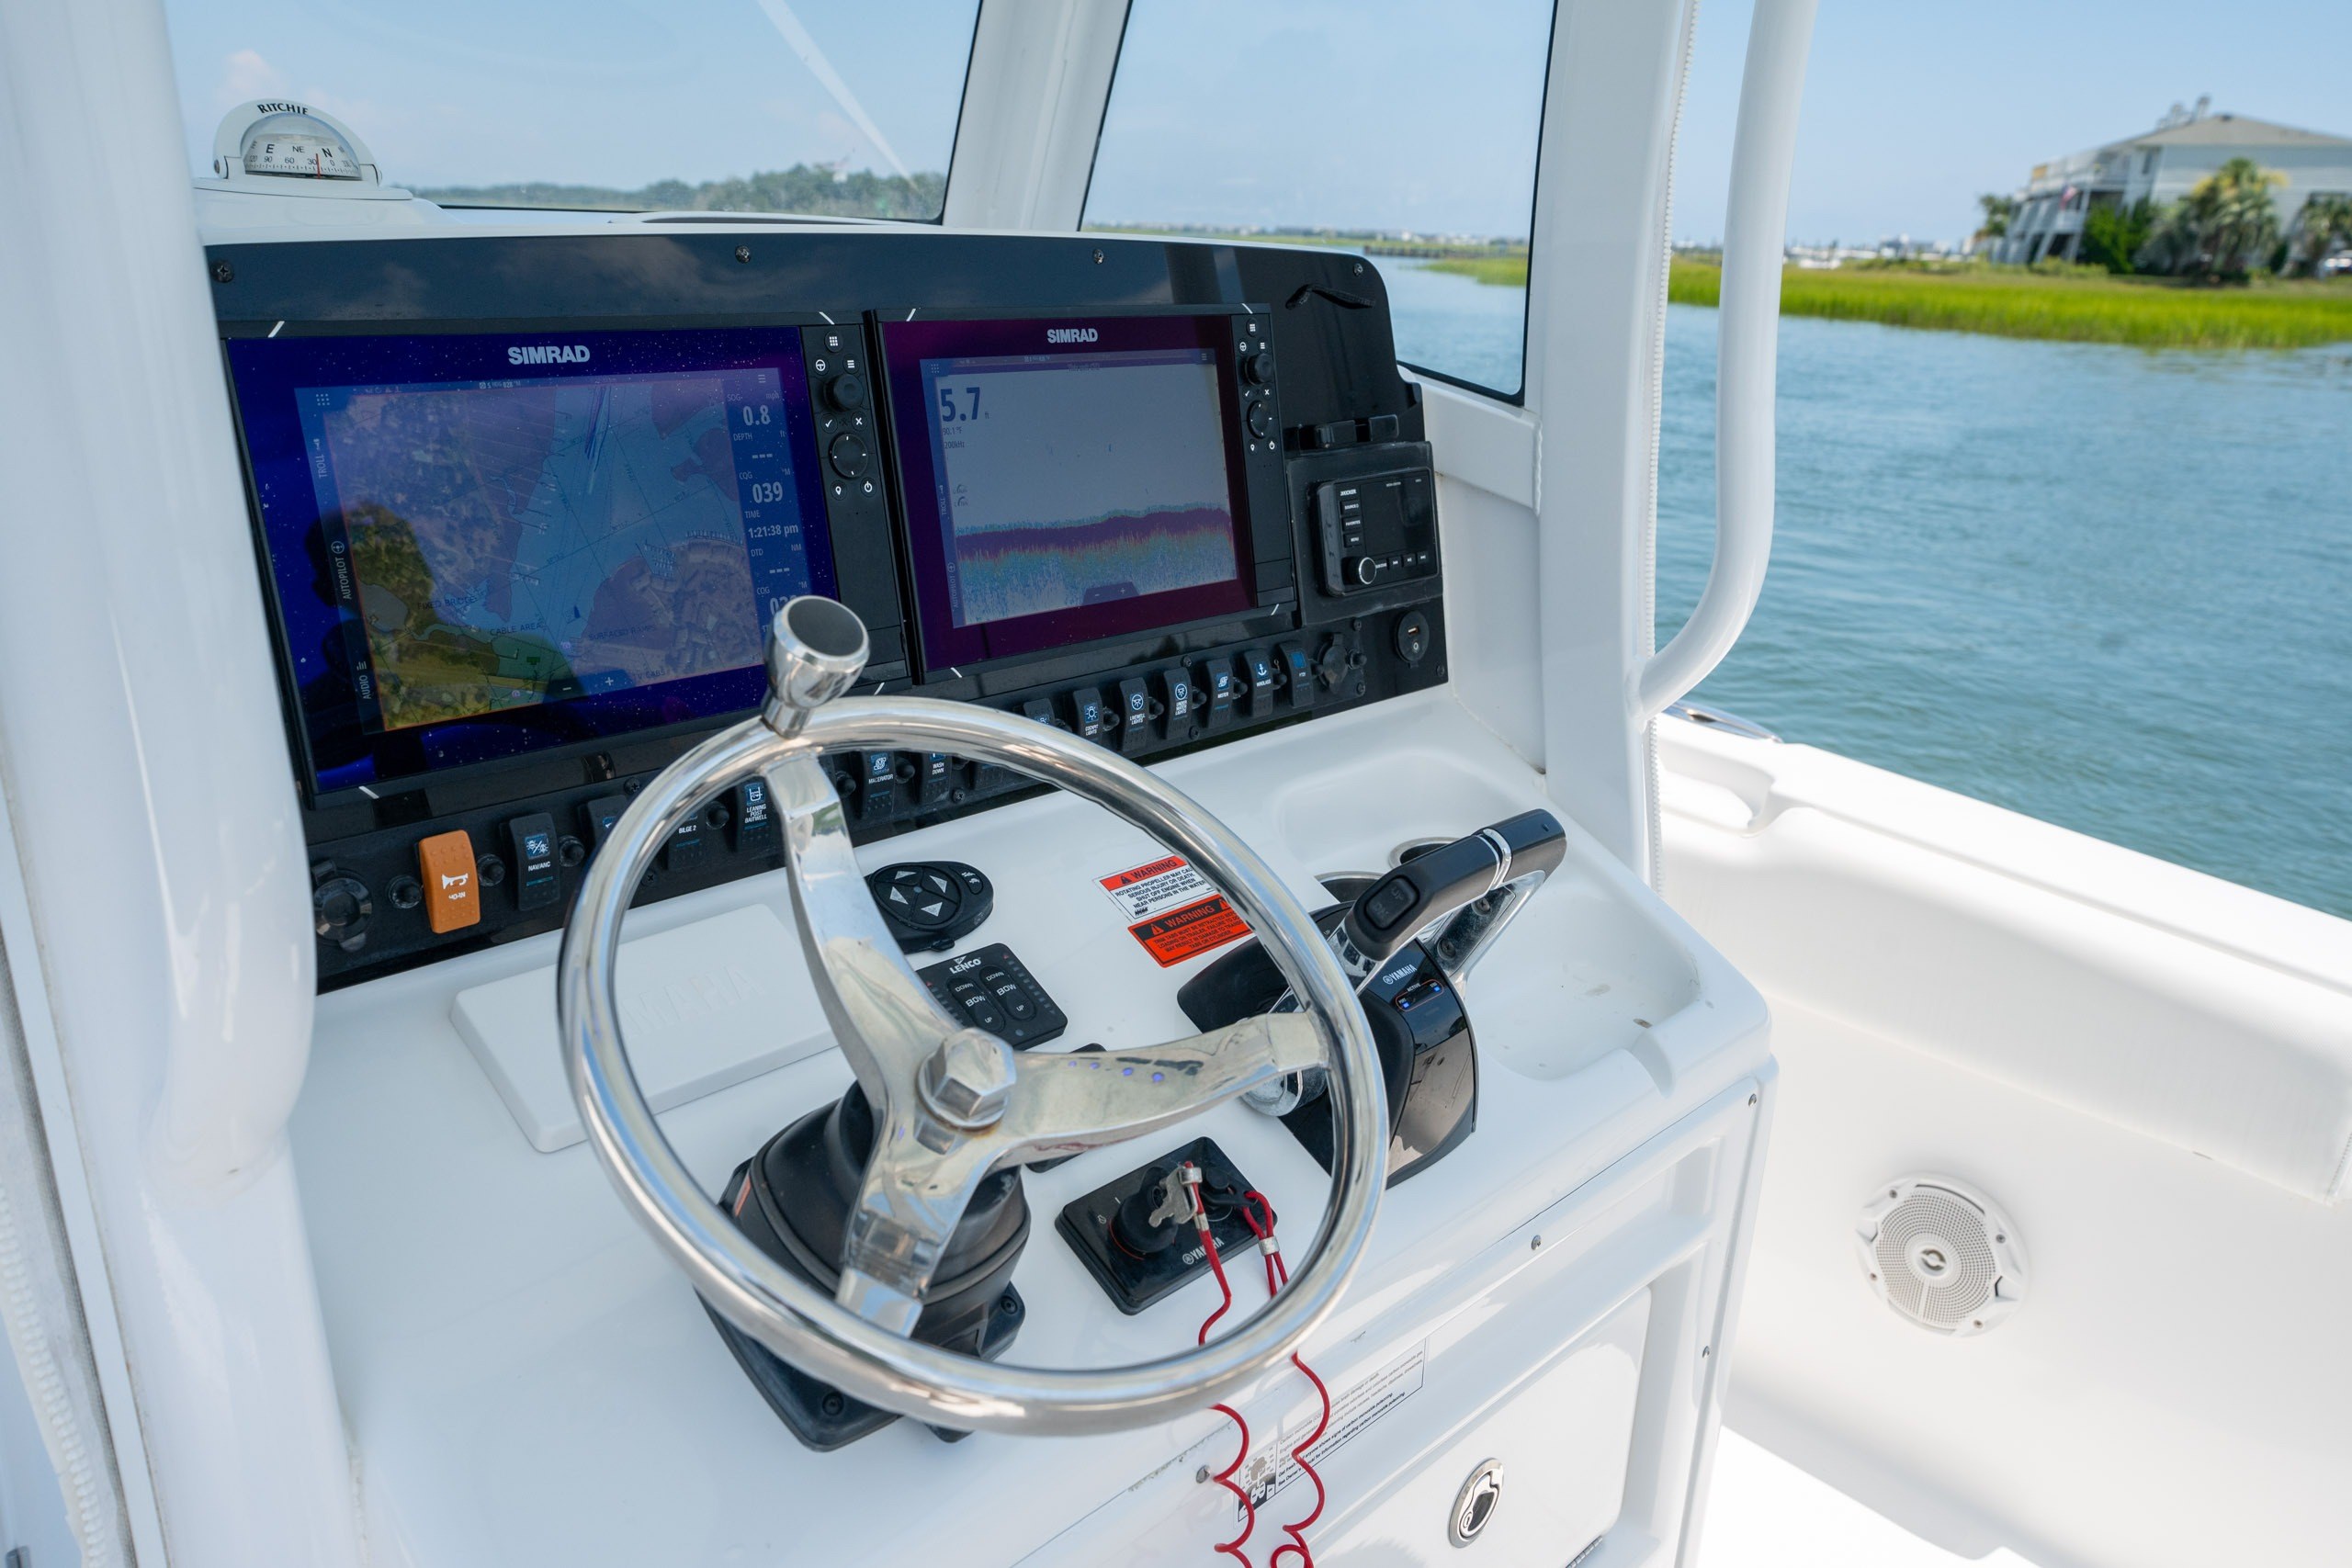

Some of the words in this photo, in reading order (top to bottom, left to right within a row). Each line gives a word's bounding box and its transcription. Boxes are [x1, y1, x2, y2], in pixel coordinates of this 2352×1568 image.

[257, 103, 309, 115] RITCHIE
[266, 143, 275, 153] E
[292, 145, 305, 153] NE
[322, 148, 333, 158] N
[1046, 328, 1099, 344] SIMRAD
[507, 344, 591, 366] SIMRAD
[766, 391, 780, 401] mph
[941, 387, 980, 423] 5.7
[742, 404, 771, 426] 0.8
[733, 433, 752, 442] DEPTH
[315, 454, 327, 479] TROLL
[752, 481, 783, 504] 039
[745, 510, 761, 519] TIME
[748, 526, 782, 539] 1:21:38
[784, 525, 798, 536] pm
[751, 548, 763, 557] DTD
[791, 544, 802, 552] NM
[334, 557, 353, 600] AUTOPILOT
[757, 586, 770, 595] COG
[417, 600, 442, 610] FIXED
[490, 626, 517, 636] CABLE
[520, 621, 544, 631] AREA
[359, 673, 372, 700] AUDIO
[933, 761, 944, 770] WASH
[746, 804, 767, 813] LEANING
[750, 809, 763, 818] POST
[678, 826, 692, 834] BILGE
[527, 861, 551, 872] NAV/ANC
[1131, 860, 1177, 879] WARNING
[1114, 886, 1140, 897] ROTATING
[1141, 874, 1170, 887] PROPELLER
[1128, 888, 1151, 898] SERIOUS
[1151, 882, 1169, 891] INJURY
[1162, 884, 1181, 892] ENGINE
[1133, 900, 1148, 908] NEAR
[1149, 892, 1172, 904] PERSONS
[1164, 905, 1215, 928] WARNING
[949, 958, 982, 974] LENCO
[1389, 964, 1418, 981] YAMAHA
[985, 971, 1005, 981] DOWN
[955, 983, 974, 993] DOWN
[996, 983, 1017, 996] BOW
[1407, 982, 1421, 992] ACTIVE
[966, 994, 987, 1007] BOW
[1190, 1236, 1225, 1261] YAHA
[1342, 1425, 1358, 1438] regarding
[1360, 1416, 1371, 1426] carbon
[1372, 1404, 1387, 1416] monoxide
[1306, 1446, 1318, 1457] anyone
[1319, 1437, 1330, 1446] shows
[1331, 1430, 1340, 1438] signs
[1346, 1417, 1357, 1427] carbon
[1358, 1404, 1374, 1418] monoxide
